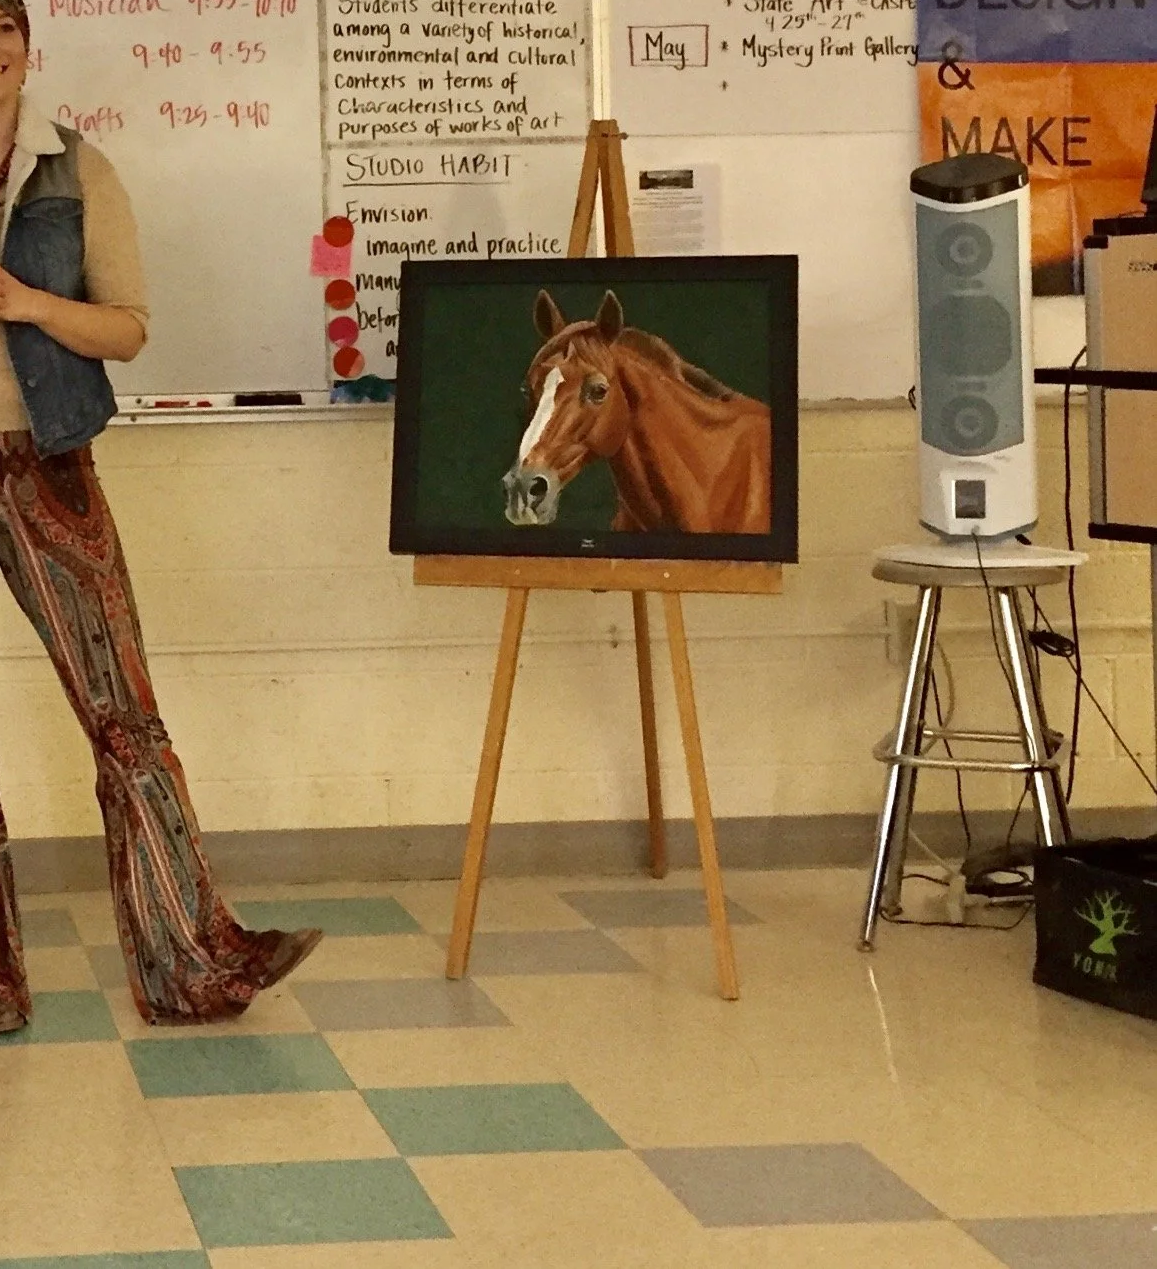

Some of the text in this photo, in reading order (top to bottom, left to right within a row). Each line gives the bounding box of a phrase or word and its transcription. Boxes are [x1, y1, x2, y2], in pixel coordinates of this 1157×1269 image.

[333, 22, 391, 48] among
[400, 22, 411, 37] a
[502, 20, 586, 46] historical,
[333, 45, 576, 67] environmental and cultural
[645, 31, 686, 70] May
[742, 36, 921, 67] Mystery Print Gallery
[938, 41, 975, 91] &
[419, 70, 434, 91] in
[444, 70, 494, 91] terms
[501, 72, 519, 95] of
[337, 95, 529, 116] Characteristics and
[338, 111, 566, 141] purposes of works of art
[941, 116, 1092, 168] MAKE
[346, 153, 424, 181] STUDIO
[366, 231, 562, 261] imagine and practice
[356, 301, 400, 333] befor
